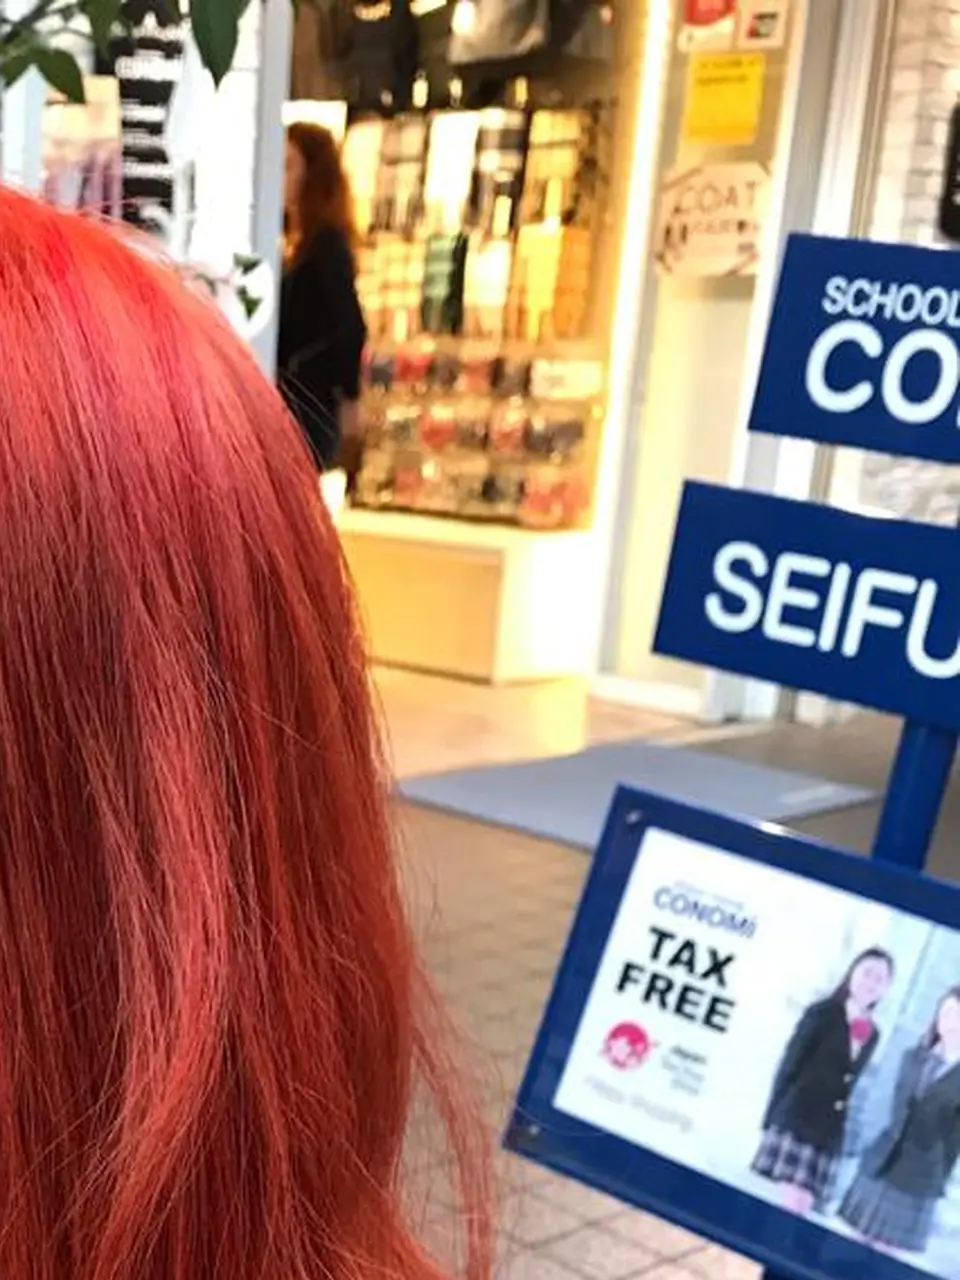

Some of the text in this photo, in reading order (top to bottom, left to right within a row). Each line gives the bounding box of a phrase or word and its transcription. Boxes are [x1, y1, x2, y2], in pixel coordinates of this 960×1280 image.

[821, 275, 960, 328] SCHOOL
[805, 318, 960, 430] CO
[704, 540, 960, 680] SEIFU
[649, 925, 734, 987] TAX
[616, 961, 735, 1033] FREE
